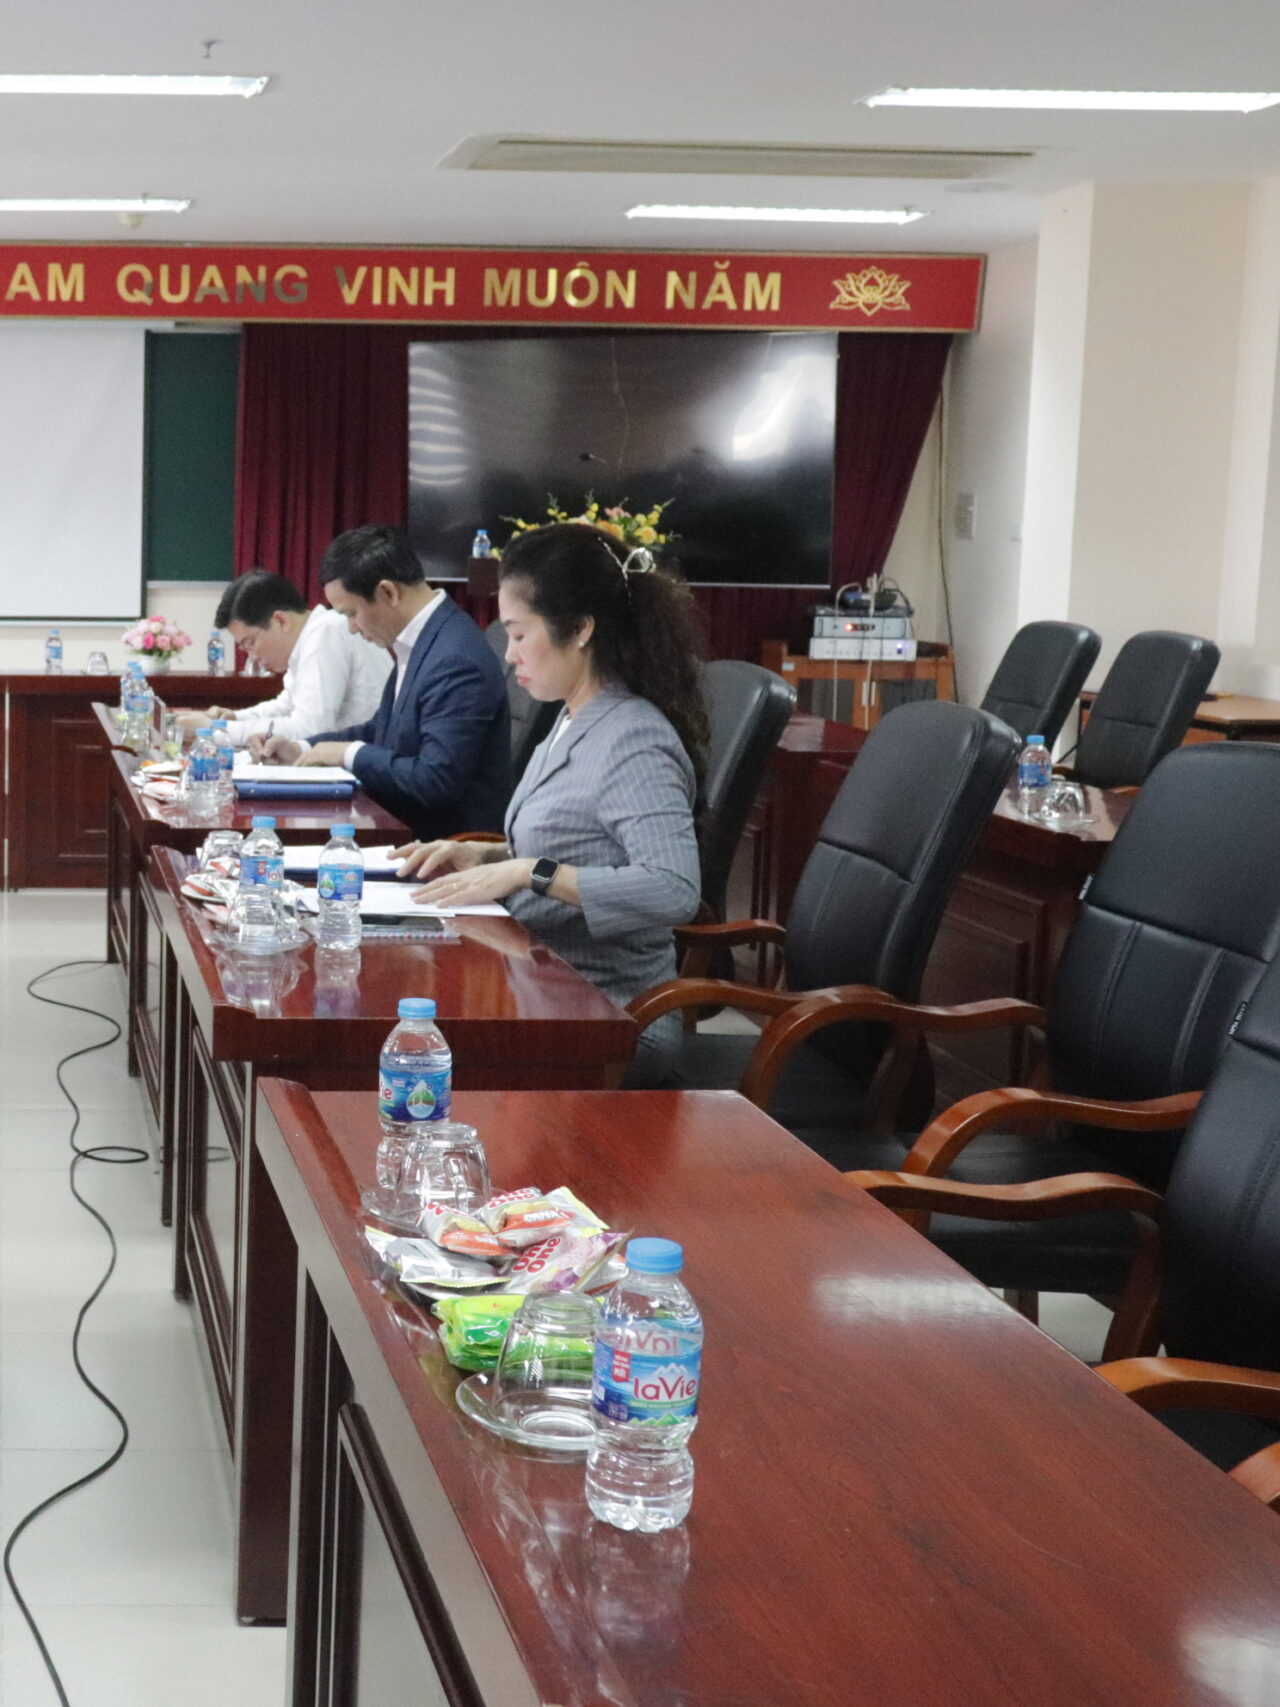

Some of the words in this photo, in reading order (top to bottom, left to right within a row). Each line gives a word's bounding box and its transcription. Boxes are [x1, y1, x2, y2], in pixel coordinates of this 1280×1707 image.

[116, 263, 309, 305] QUANG
[335, 266, 456, 306] VINH
[483, 261, 636, 308] MUÔN
[665, 260, 781, 311] NĂM
[633, 1376, 696, 1400] laVie
